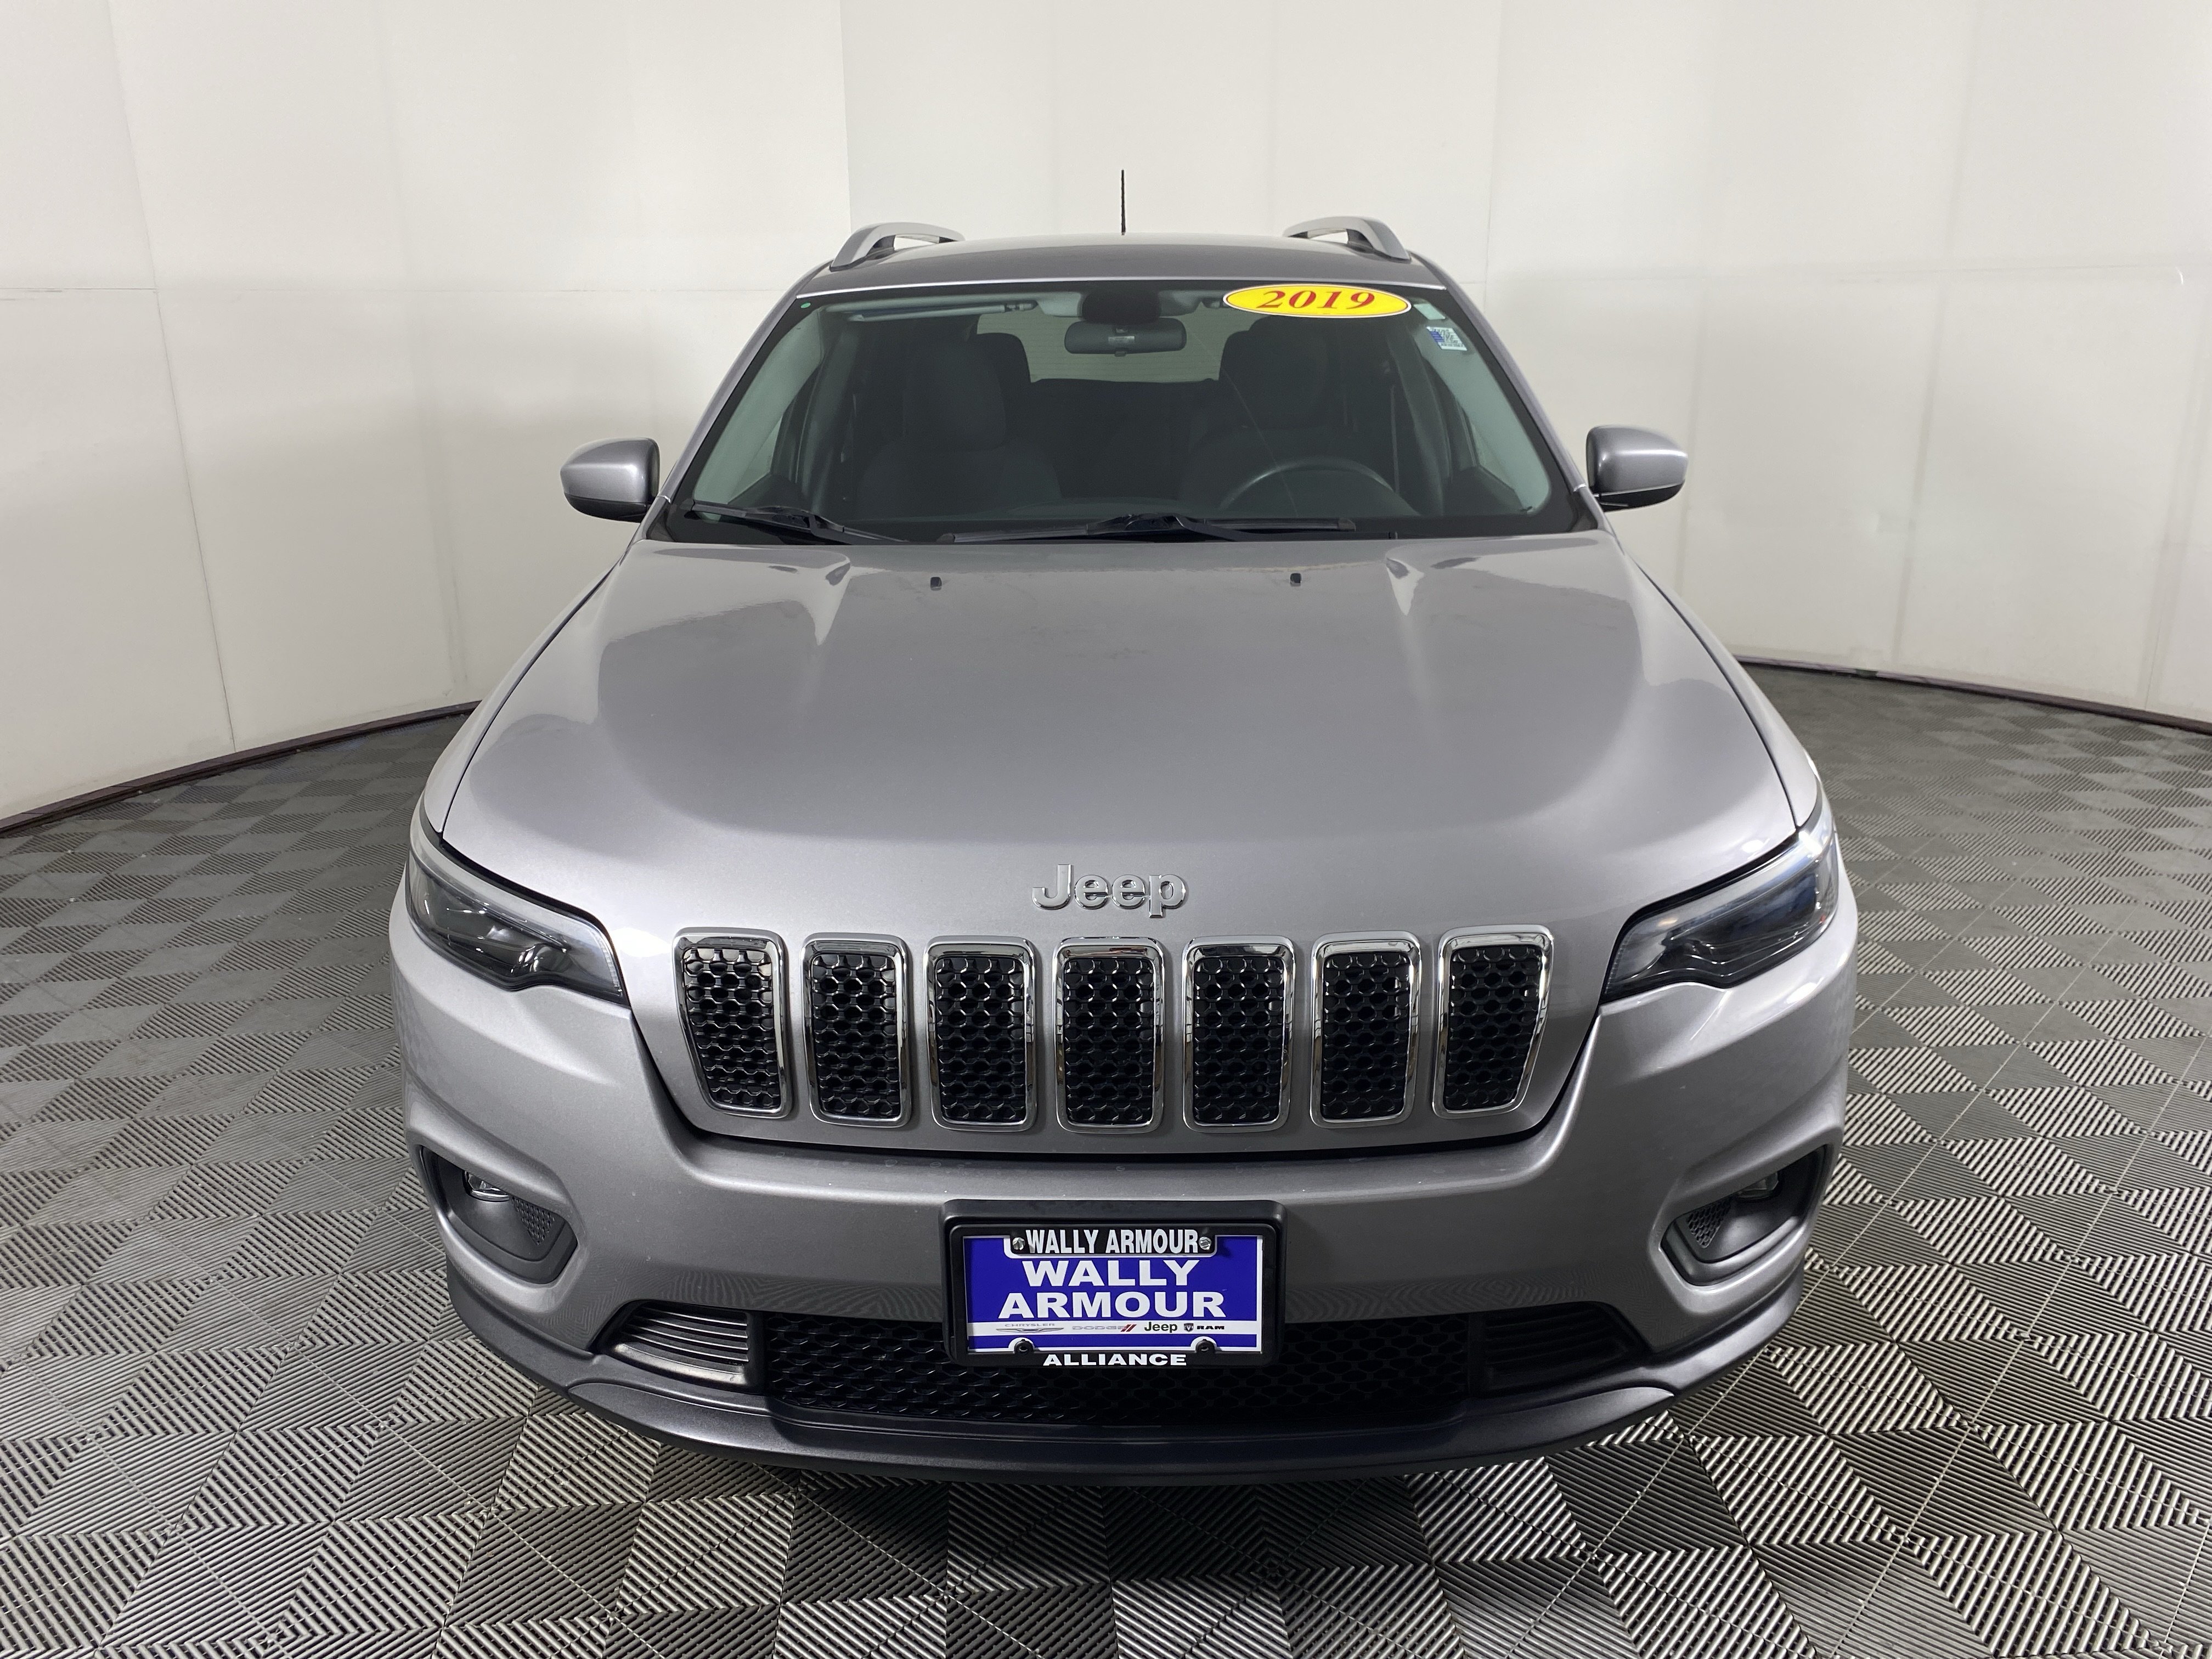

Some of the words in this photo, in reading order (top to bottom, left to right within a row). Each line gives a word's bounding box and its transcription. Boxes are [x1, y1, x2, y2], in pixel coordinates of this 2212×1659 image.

[1256, 290, 1375, 309] 2019
[1031, 864, 1187, 919] Jeep
[1025, 1229, 1099, 1254] WALLY
[1105, 1228, 1198, 1254] ARMOUR
[1022, 1260, 1200, 1287] WALLY
[997, 1291, 1226, 1319] ARMOUR
[1144, 1321, 1178, 1333] Jeep
[1042, 1353, 1187, 1366] ALLIANCE
